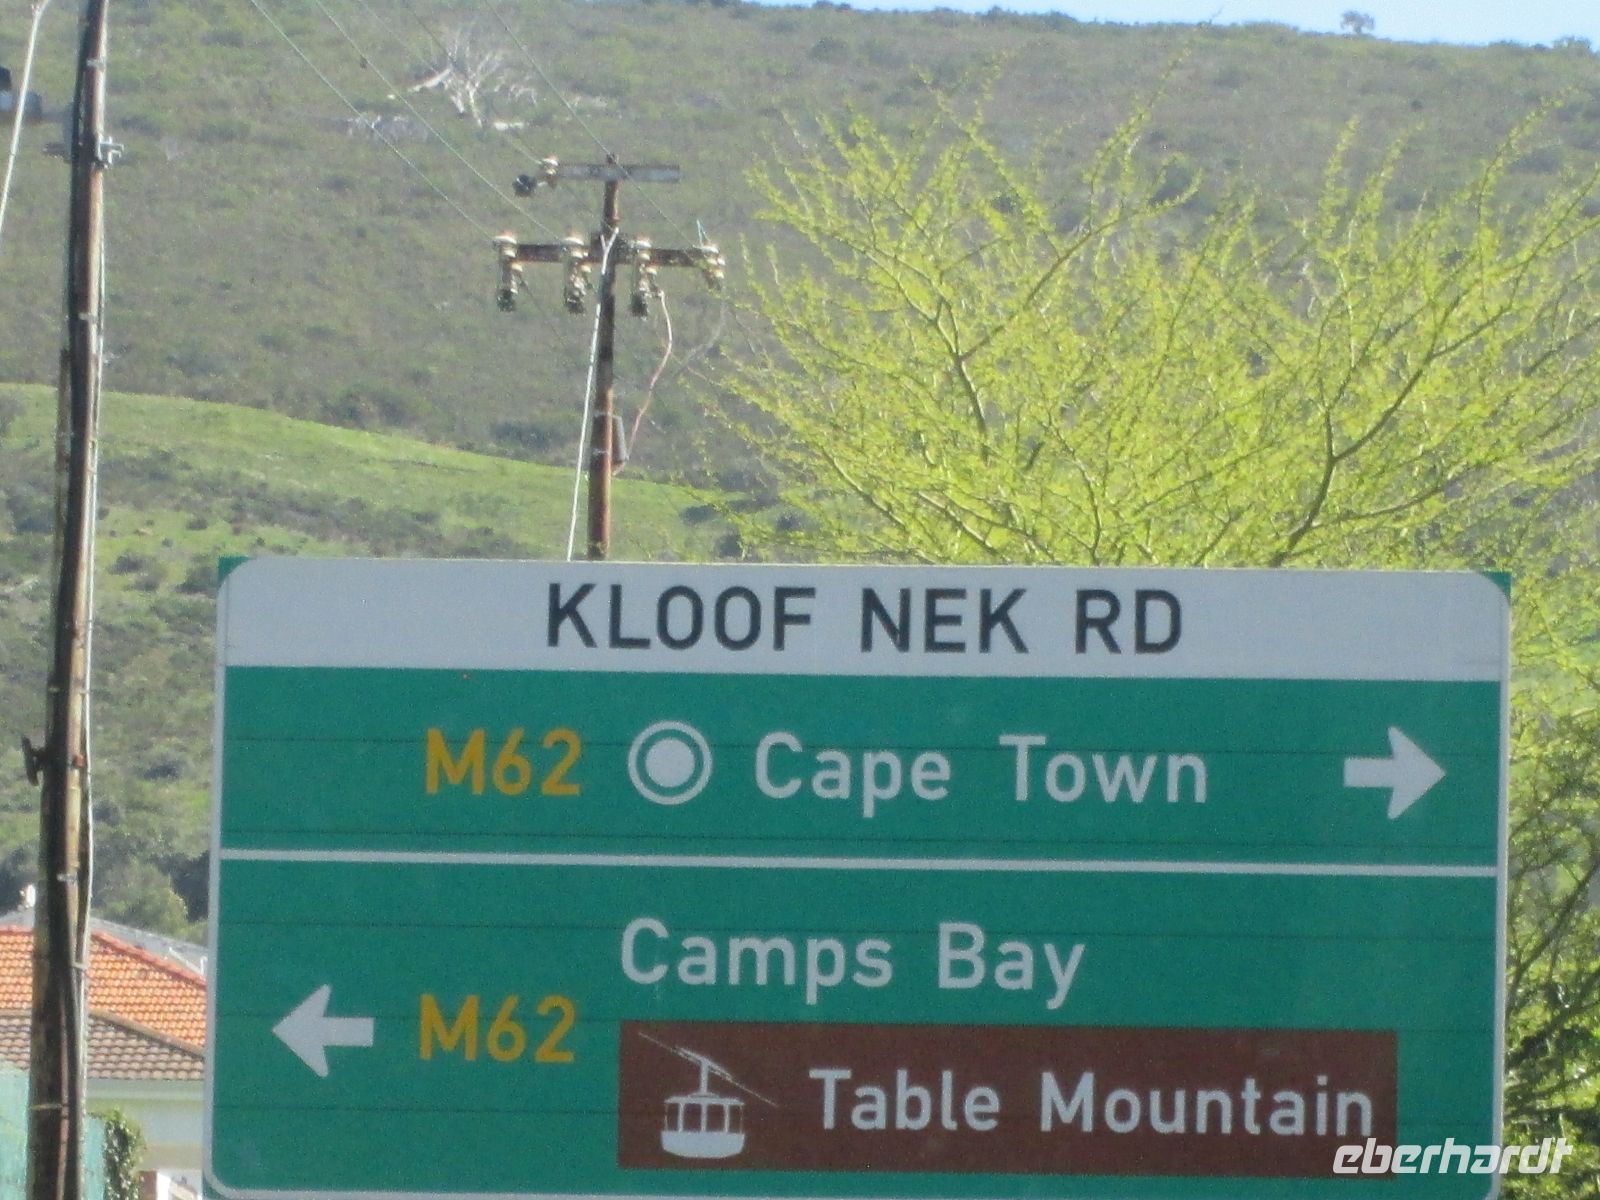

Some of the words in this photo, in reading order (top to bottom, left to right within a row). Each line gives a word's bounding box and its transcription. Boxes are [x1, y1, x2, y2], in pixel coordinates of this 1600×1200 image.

[547, 582, 817, 652] KLOOF
[860, 587, 1029, 654] NEK
[1075, 588, 1183, 655] RD
[425, 728, 581, 796] M62
[755, 731, 952, 819] Cape
[999, 734, 1207, 803] Town
[621, 918, 893, 1005] Camps
[938, 922, 1085, 1010] Bay
[419, 995, 576, 1062] M62
[808, 1067, 1001, 1131] Table
[1040, 1072, 1373, 1138] Mountain
